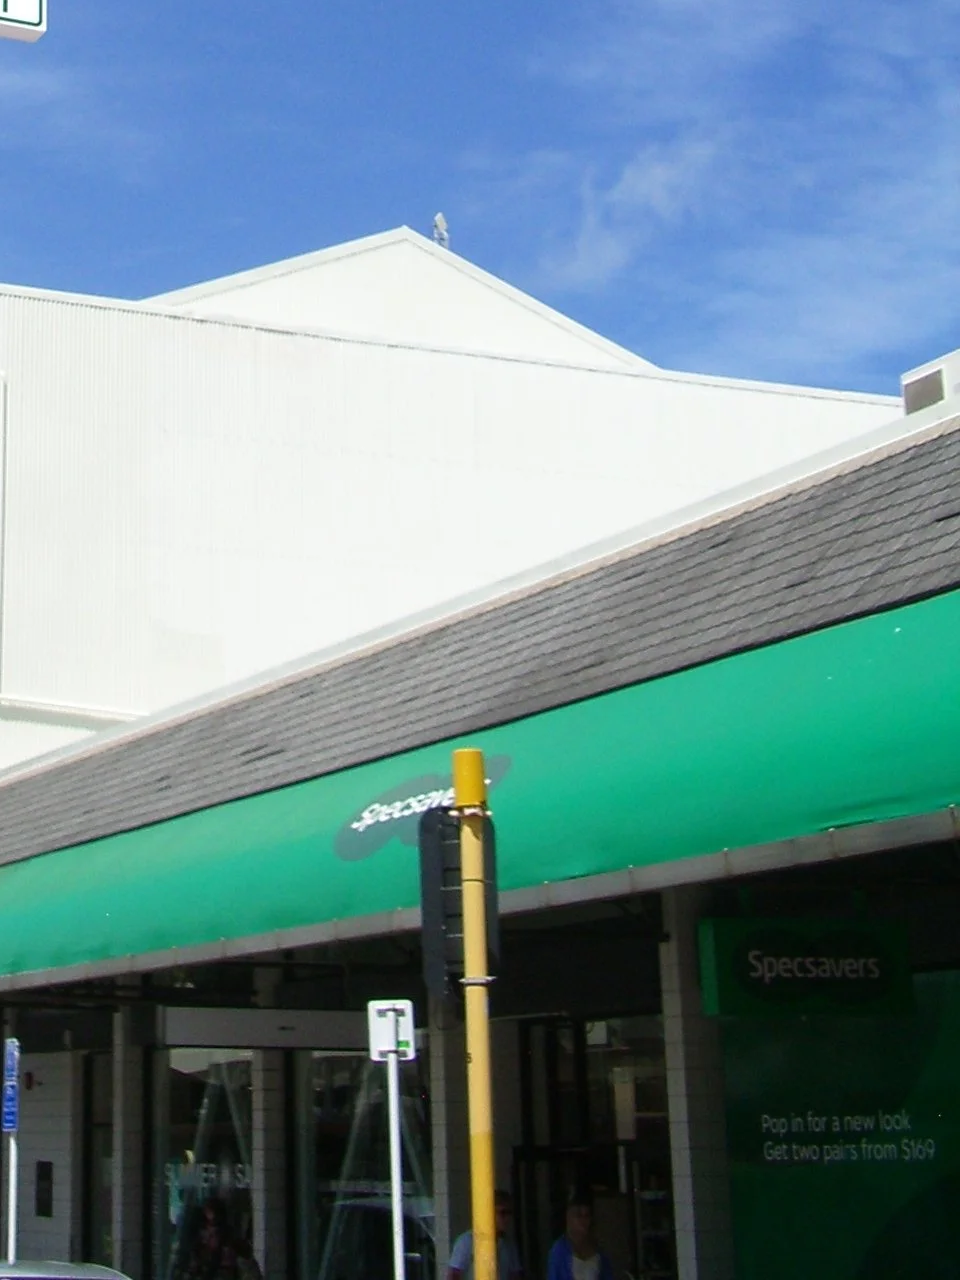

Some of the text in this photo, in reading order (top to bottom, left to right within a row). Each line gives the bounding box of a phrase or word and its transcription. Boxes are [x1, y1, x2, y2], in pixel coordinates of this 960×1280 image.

[351, 786, 458, 833] Specsave
[747, 950, 881, 984] Specsavers
[761, 1109, 912, 1137] Pop in for a new look
[763, 1137, 936, 1164] Get two pairs from $169
